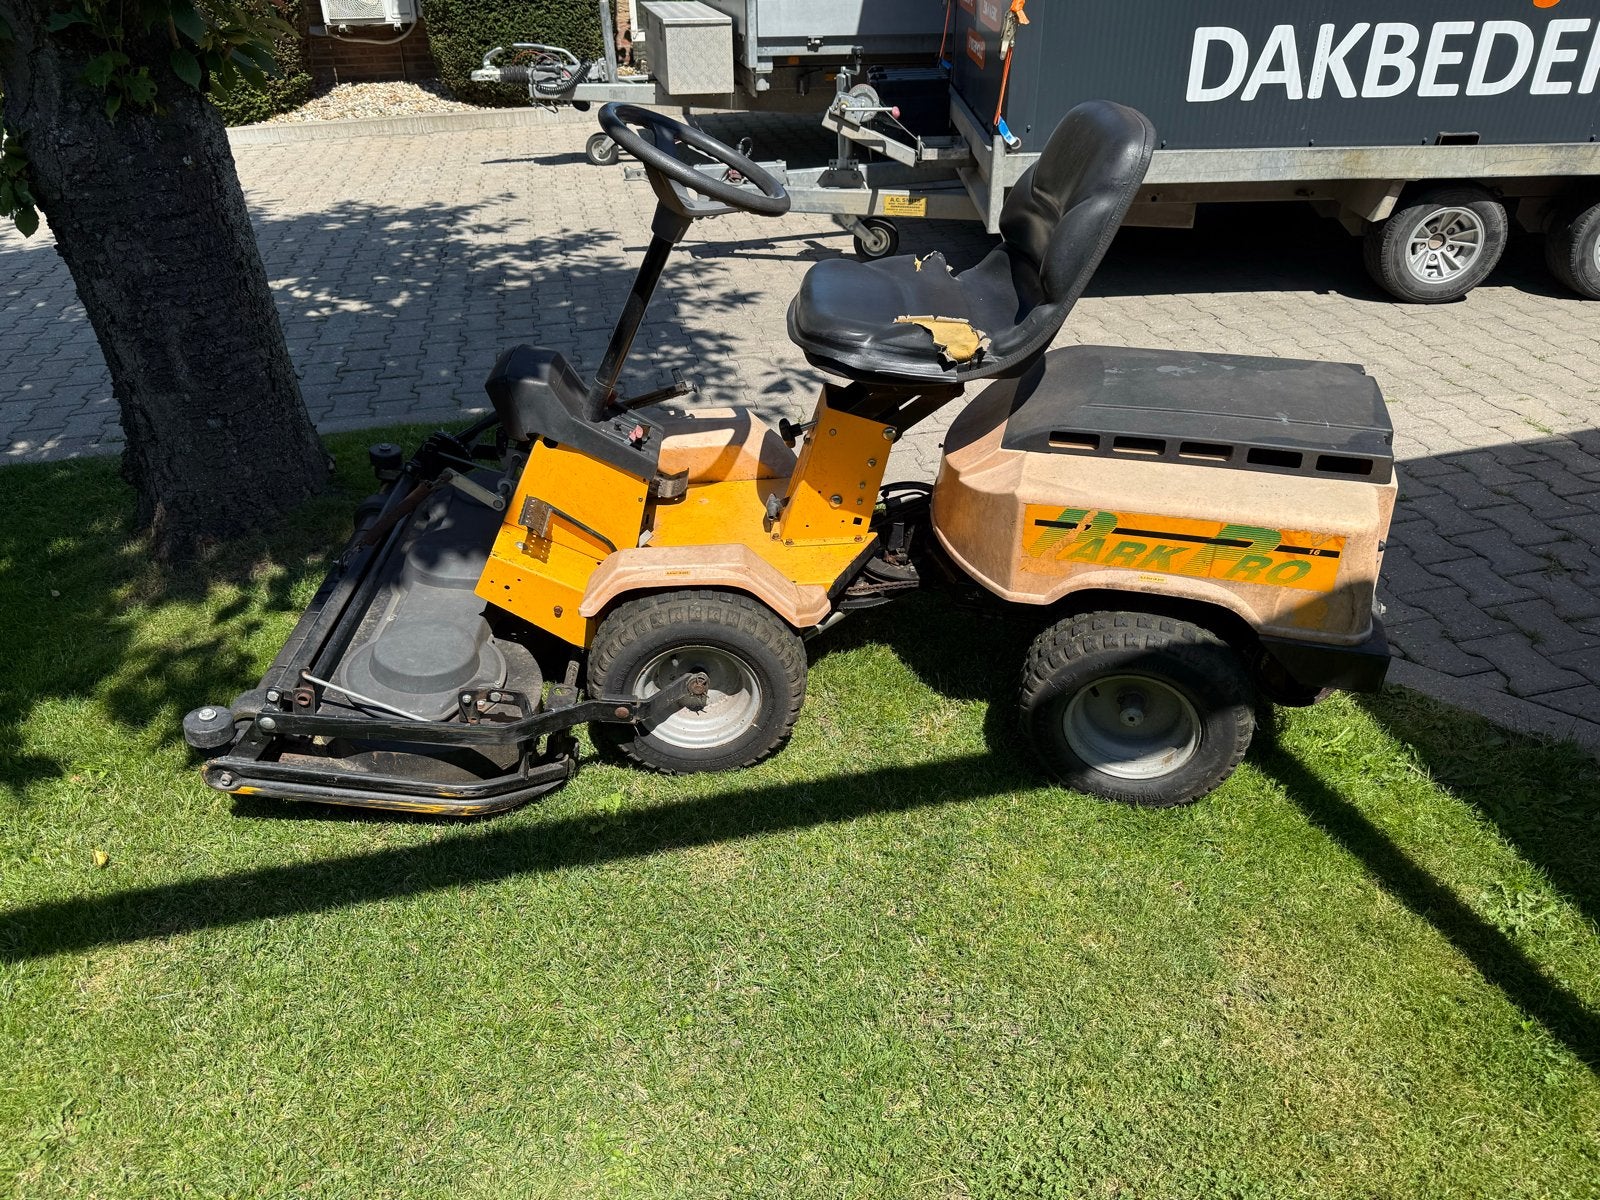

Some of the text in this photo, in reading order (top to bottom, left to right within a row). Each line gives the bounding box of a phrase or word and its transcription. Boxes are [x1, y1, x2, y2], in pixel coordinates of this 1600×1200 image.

[1026, 507, 1312, 585] PARK PRO
[1308, 548, 1321, 556] 16
